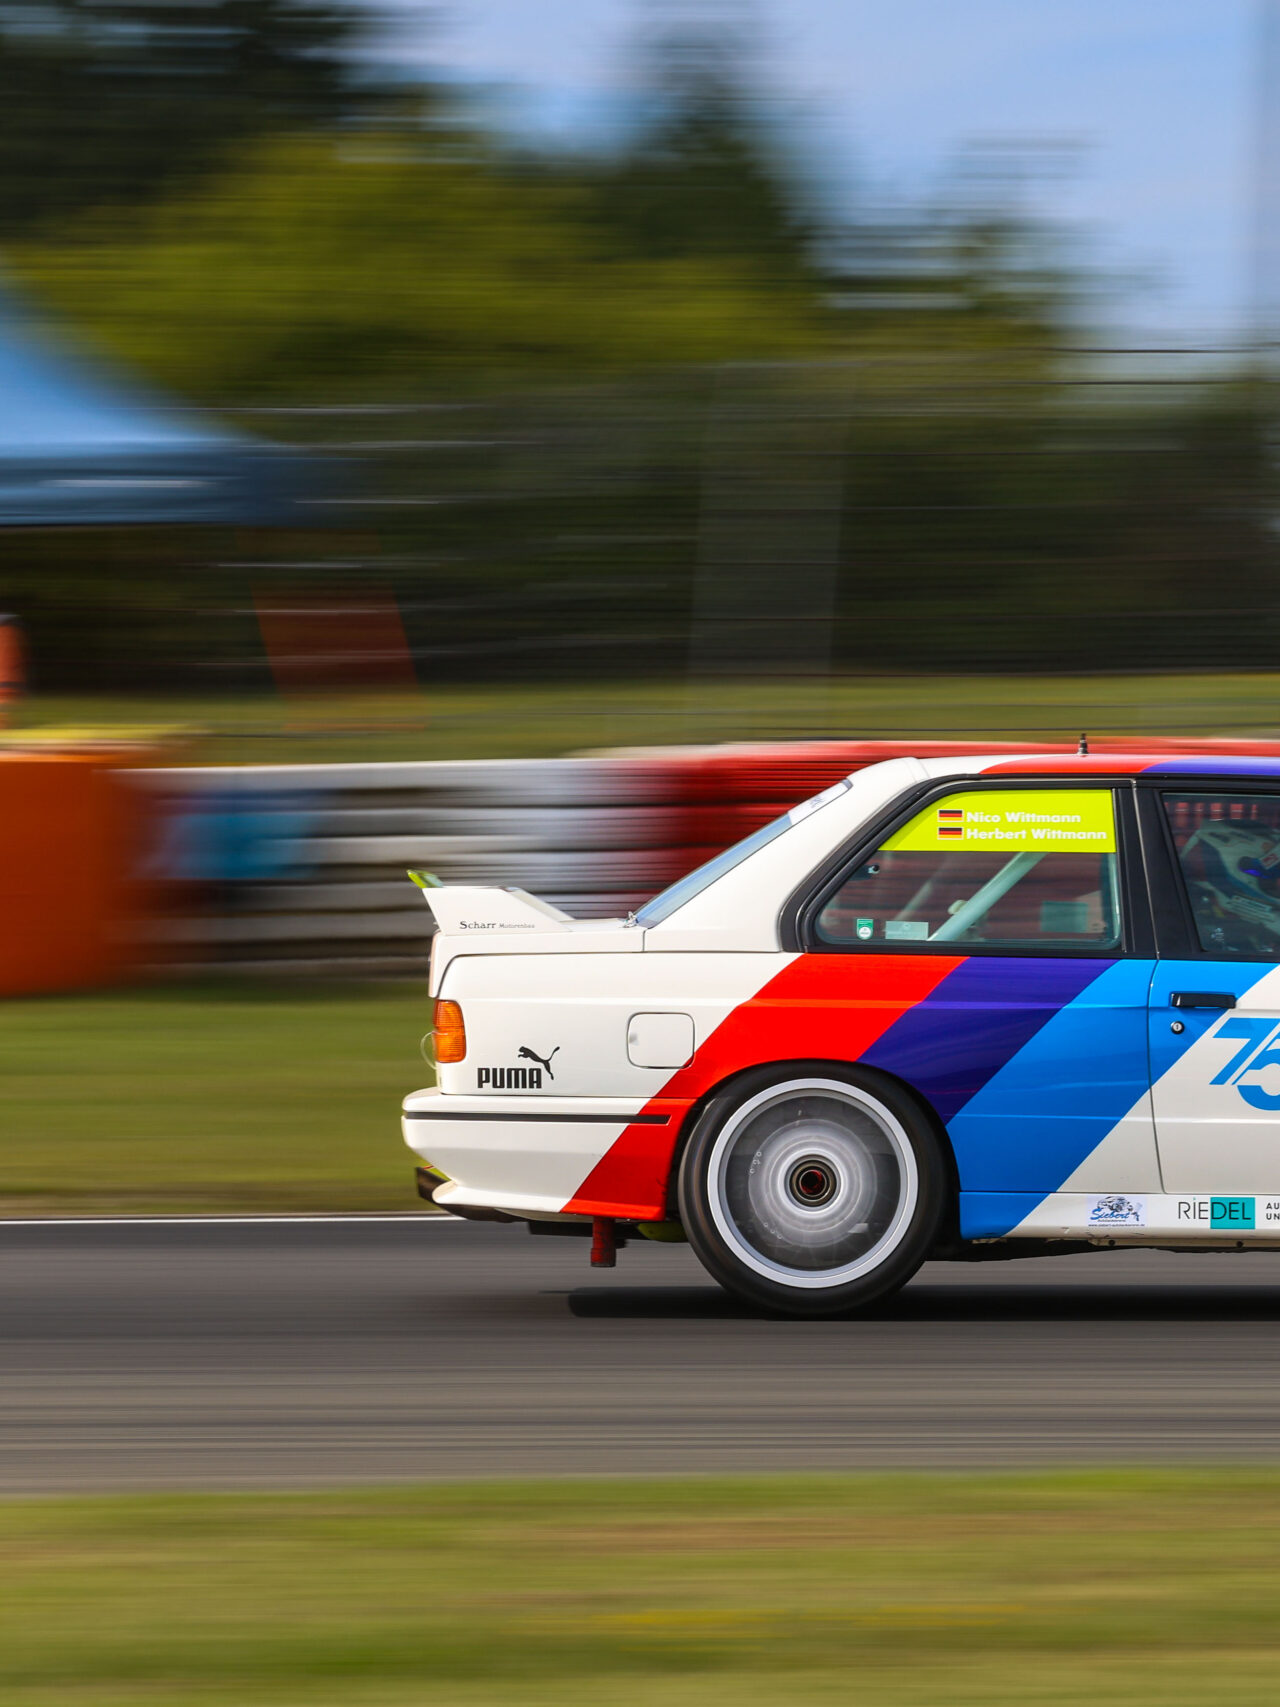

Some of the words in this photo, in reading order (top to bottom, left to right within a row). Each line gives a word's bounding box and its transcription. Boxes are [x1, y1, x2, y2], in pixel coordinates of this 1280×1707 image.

[966, 812, 1001, 824] Nico
[1005, 812, 1081, 824] Wittmann
[966, 828, 1027, 840] Herbert
[1031, 829, 1107, 840] Wittmann
[459, 920, 496, 930] Scharr
[477, 1067, 542, 1089] PUMA
